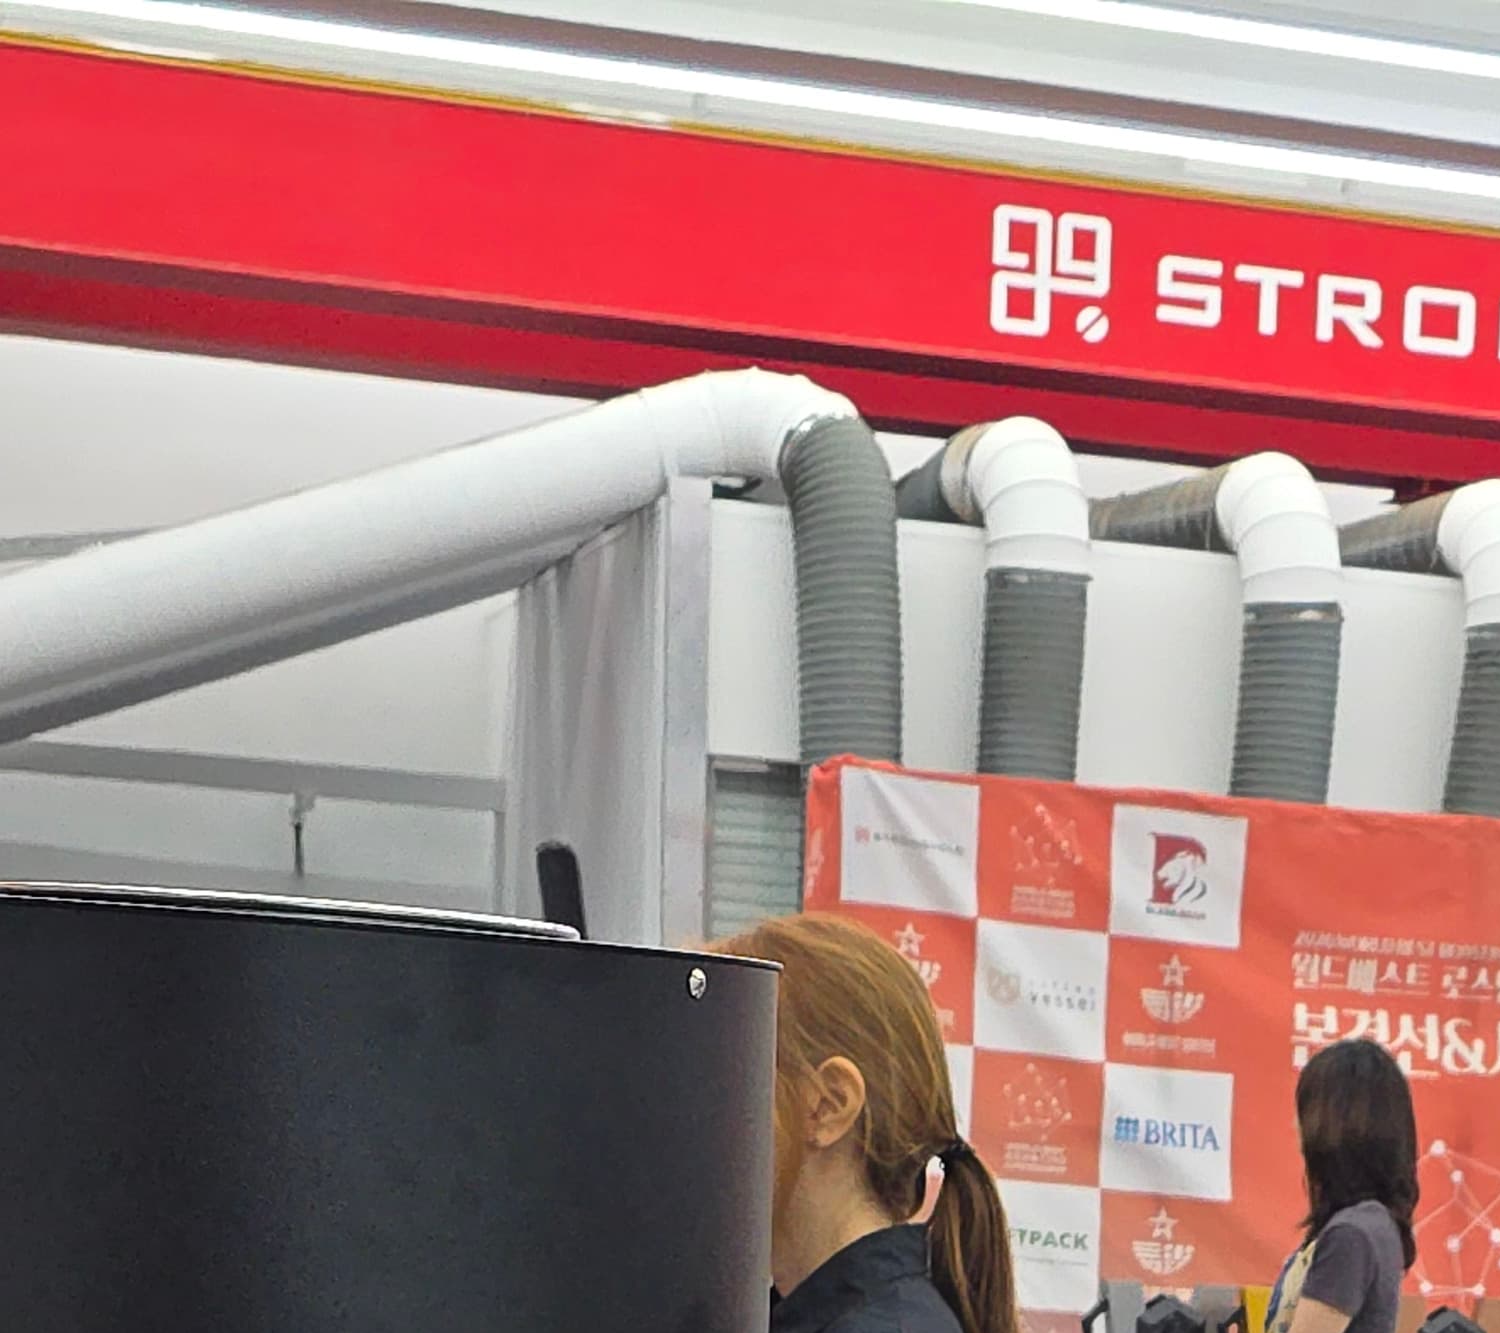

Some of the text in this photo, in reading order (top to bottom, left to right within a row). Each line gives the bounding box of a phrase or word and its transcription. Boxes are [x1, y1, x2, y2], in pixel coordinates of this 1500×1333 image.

[1292, 952, 1430, 997] 월드베스트
[1144, 1118, 1220, 1151] BRITA
[1009, 1227, 1089, 1251] TPACK
